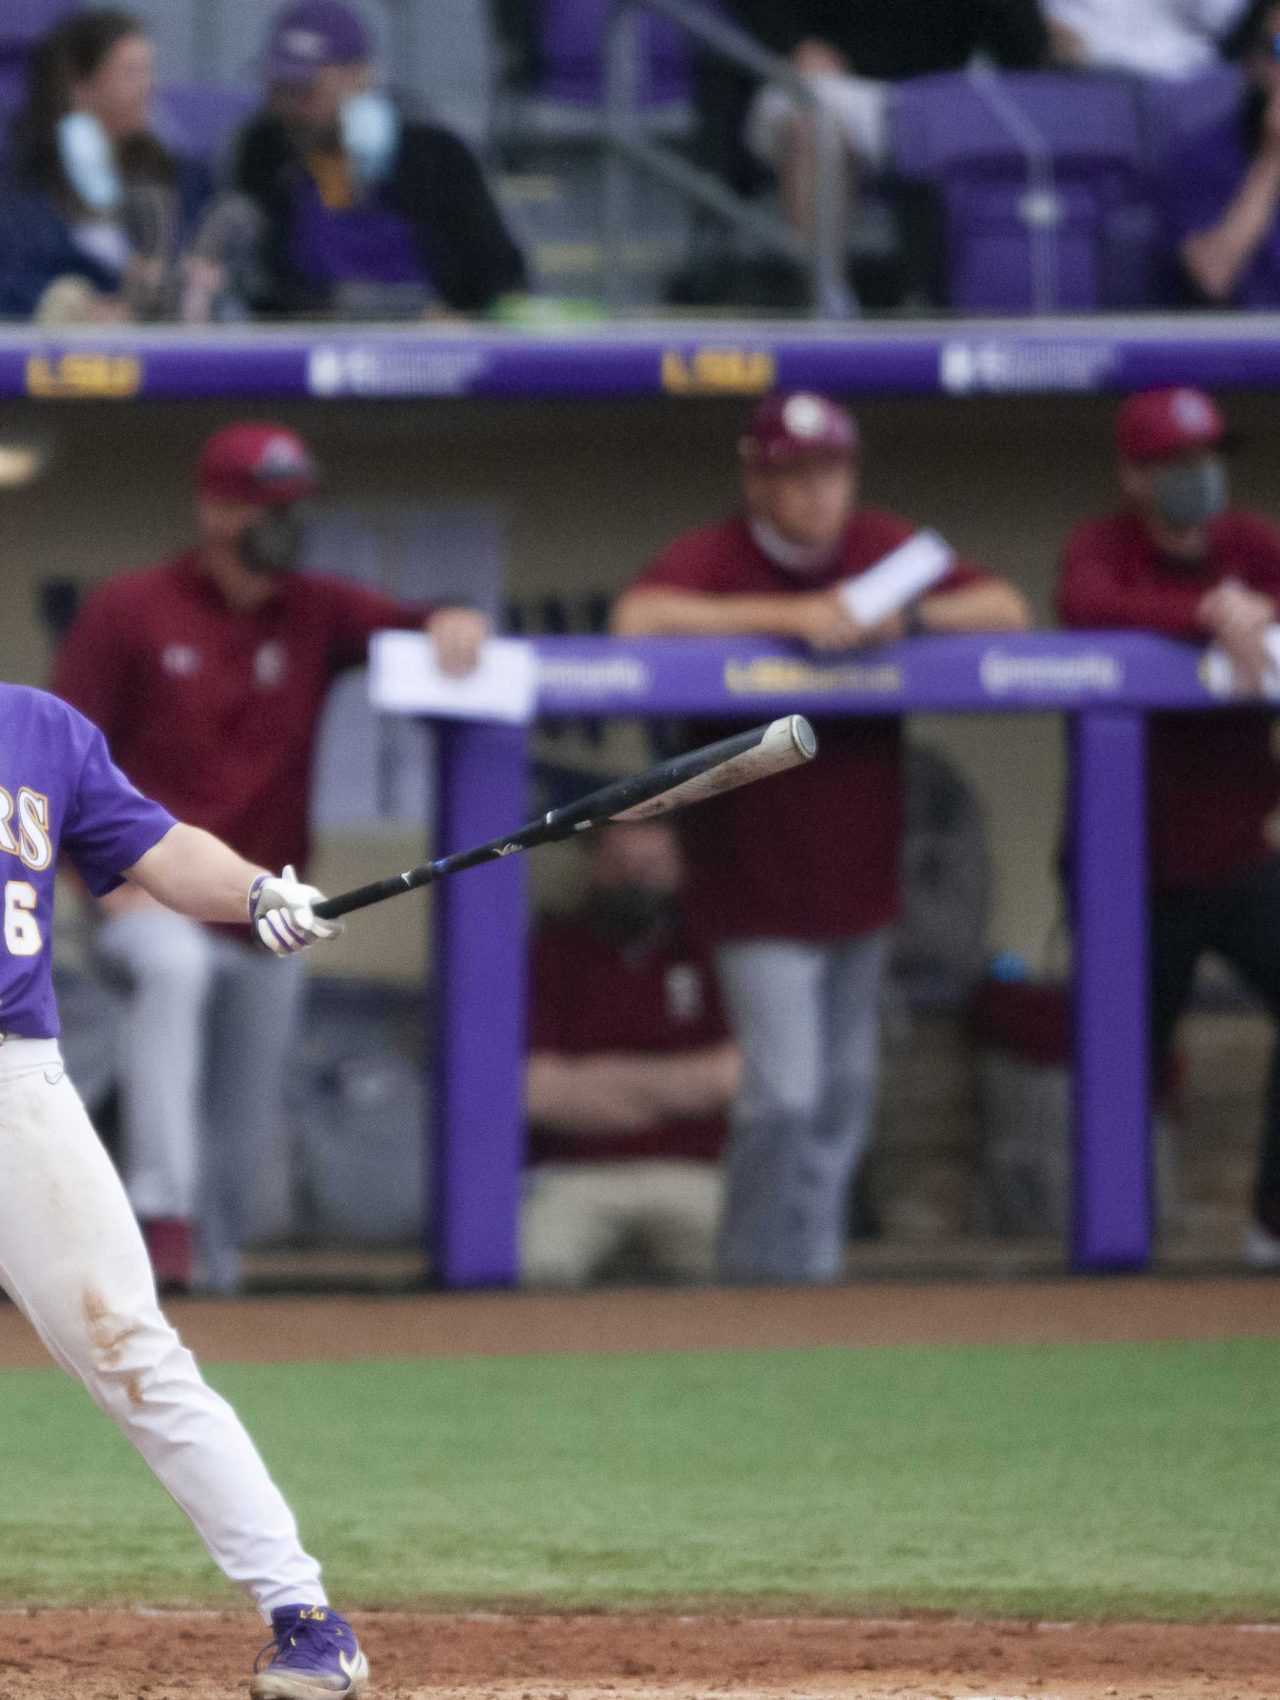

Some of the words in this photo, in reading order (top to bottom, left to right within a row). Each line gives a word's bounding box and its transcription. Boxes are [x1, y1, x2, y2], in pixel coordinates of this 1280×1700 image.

[27, 353, 140, 397] LSU
[660, 348, 774, 394] LSU
[4, 880, 43, 956] 6
